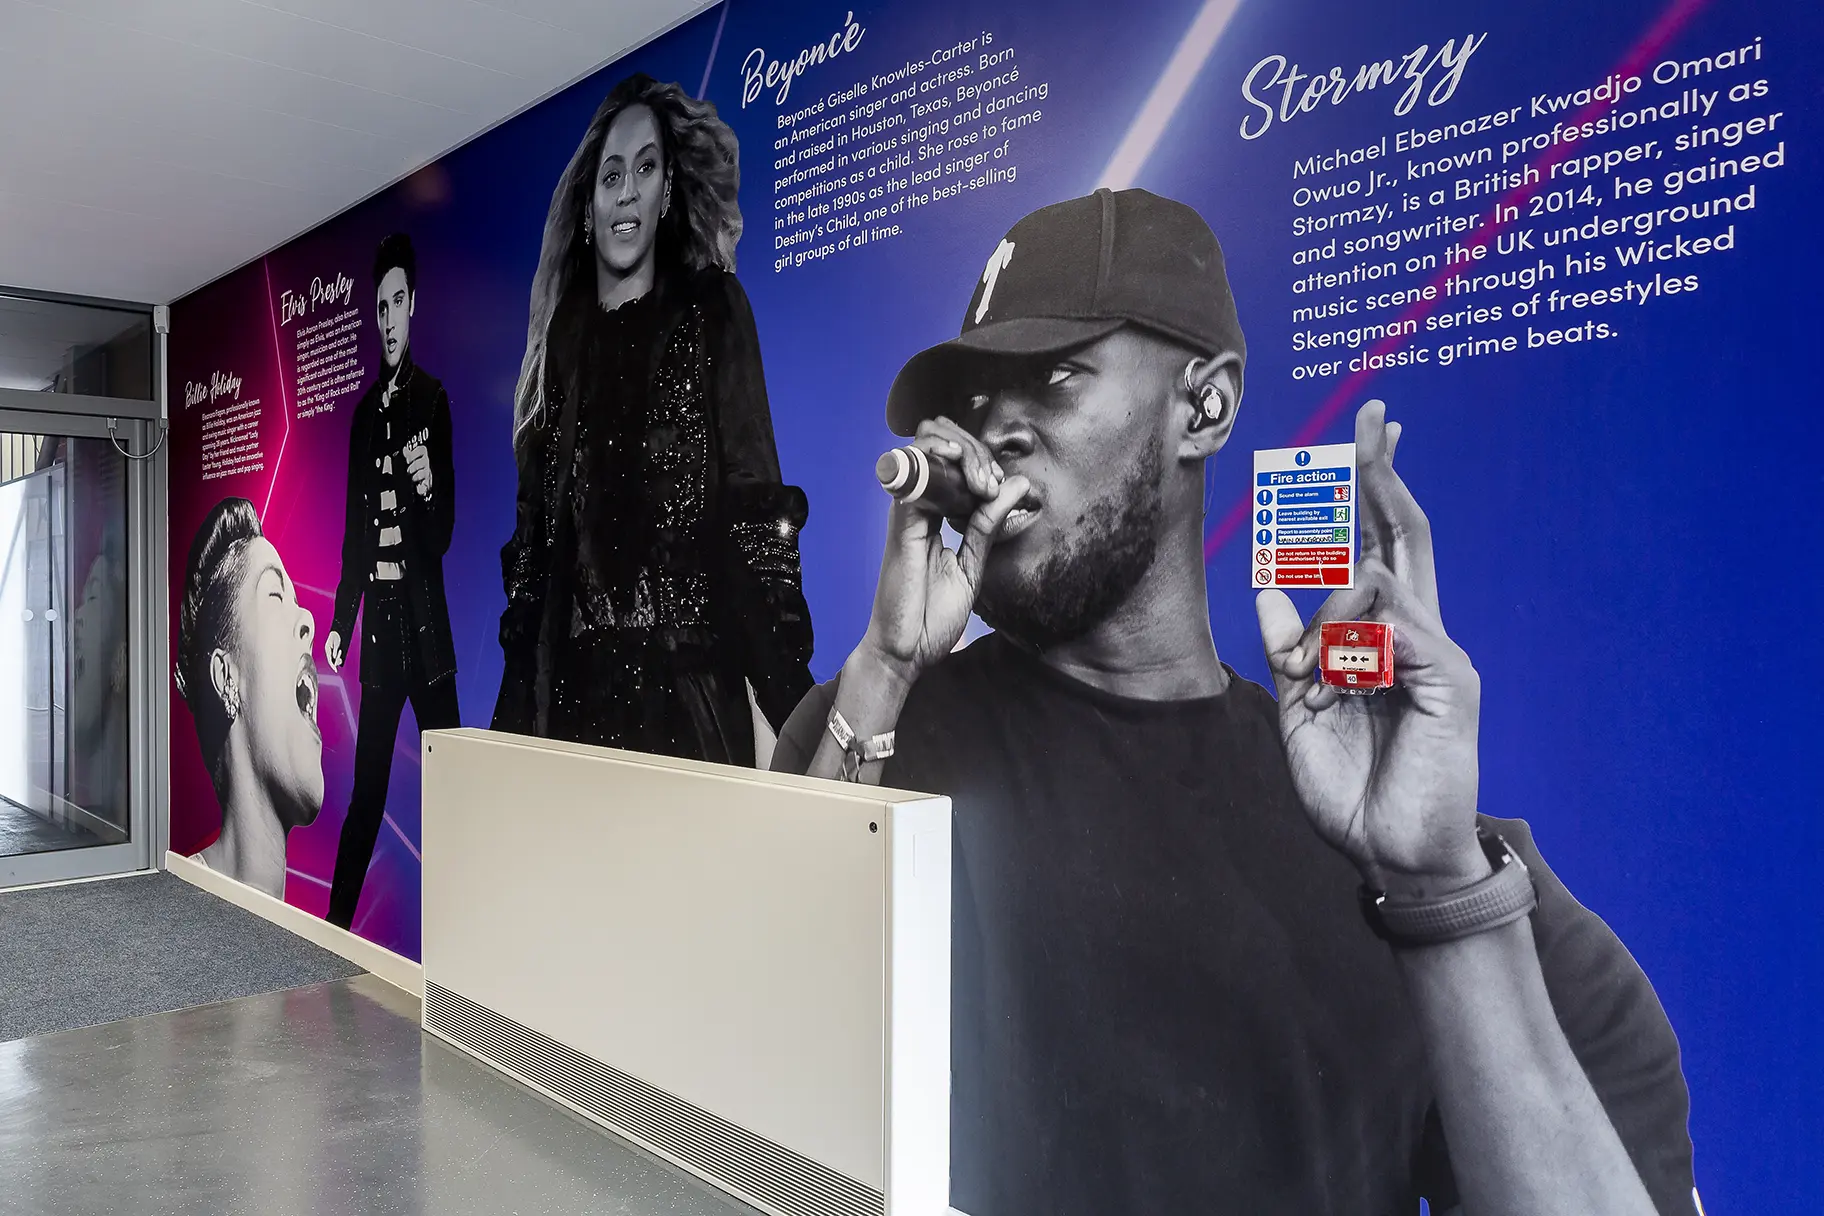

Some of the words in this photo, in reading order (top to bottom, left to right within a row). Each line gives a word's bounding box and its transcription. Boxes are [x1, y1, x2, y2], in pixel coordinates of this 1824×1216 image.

[741, 11, 866, 109] Beyoncé
[774, 137, 788, 150] an
[790, 114, 846, 144] American
[849, 97, 888, 121] singer
[891, 81, 916, 104] and
[920, 65, 974, 93] actress.
[980, 48, 1014, 70] Born
[778, 98, 825, 129] Beyoncé
[827, 82, 868, 107] Giselle
[872, 38, 978, 91] Knowles-Carter
[982, 31, 992, 46] is
[1239, 31, 1488, 141] Stormzy
[1293, 136, 1386, 180] Michael
[1396, 106, 1522, 153] Ebenazer
[1531, 74, 1642, 118] Kwadjo
[1652, 36, 1762, 84] Omari
[774, 150, 796, 170] and
[799, 135, 834, 161] raised
[837, 133, 848, 147] in
[852, 114, 906, 141] Houston,
[910, 96, 952, 118] Texas,
[957, 65, 1019, 102] Beyoncé
[775, 156, 834, 194] performed
[838, 154, 848, 167] in
[851, 138, 897, 162] various
[901, 119, 949, 145] singing
[953, 102, 981, 126] and
[986, 83, 1048, 114] dancing
[775, 177, 847, 210] competitions
[850, 171, 864, 184] as
[867, 167, 876, 178] a
[879, 150, 914, 174] child.
[918, 143, 944, 161] She
[948, 132, 978, 151] rose
[982, 125, 997, 139] to
[1001, 110, 1042, 133] fame
[1293, 180, 1364, 207] Owuo
[1364, 170, 1398, 197] Jr.,
[1407, 147, 1492, 181] known
[1502, 88, 1719, 164] professionally
[1728, 79, 1769, 102] as
[775, 217, 784, 230] in
[787, 211, 805, 226] the
[808, 203, 830, 219] late
[832, 191, 866, 211] 1990s
[868, 186, 883, 199] as
[886, 177, 908, 193] the
[912, 162, 941, 186] lead
[945, 151, 990, 175] singer
[993, 139, 1009, 159] of
[775, 224, 823, 249] Destiny's
[826, 211, 860, 233] Child,
[864, 207, 887, 222] one
[891, 196, 905, 214] of
[907, 193, 929, 209] the
[933, 166, 1016, 201] best-selling
[1292, 236, 1336, 265] and
[1342, 213, 1485, 255] songwriter.
[1495, 203, 1519, 224] In
[1529, 184, 1603, 217] 2014,
[1615, 176, 1653, 200] he
[1663, 141, 1785, 195] gained
[1293, 193, 1394, 237] Stormzy,
[1401, 192, 1422, 213] is
[1428, 190, 1445, 206] a
[1455, 163, 1539, 201] British
[1550, 141, 1663, 179] rapper,
[1674, 112, 1783, 151] singer
[775, 251, 792, 273] girl
[795, 243, 835, 267] groups
[838, 234, 851, 251] of
[853, 229, 868, 246] all
[871, 225, 903, 241] time.
[1292, 260, 1397, 294] attention
[1404, 254, 1436, 273] on
[1443, 242, 1487, 265] the
[1497, 228, 1535, 255] UK
[1544, 184, 1755, 247] underground
[1293, 296, 1358, 323] music
[1365, 285, 1437, 311] scene
[1444, 259, 1555, 297] through
[1566, 251, 1607, 277] his
[1614, 225, 1734, 267] Wicked
[280, 290, 308, 326] Elvis
[310, 272, 354, 312] Presley
[296, 328, 306, 339] Elvis
[305, 324, 318, 335] Aaron
[318, 318, 335, 330] Presley,
[334, 313, 344, 323] also
[343, 308, 359, 319] known
[296, 351, 310, 362] singer,
[310, 344, 328, 357] musician
[328, 339, 337, 350] and
[337, 336, 350, 347] actor.
[349, 332, 357, 342] He
[1292, 319, 1417, 351] Skengman
[1425, 304, 1503, 331] series
[1511, 291, 1541, 318] of
[1547, 273, 1699, 312] freestyles
[185, 381, 209, 410] Billie
[210, 370, 242, 404] Holiday
[1292, 360, 1344, 380] over
[1348, 344, 1430, 372] classic
[1437, 336, 1518, 366] grime
[1527, 320, 1618, 348] beats.
[301, 407, 315, 418] simply
[1270, 473, 1293, 484] Fire
[1297, 471, 1336, 482] action
[1347, 675, 1357, 683] 40
